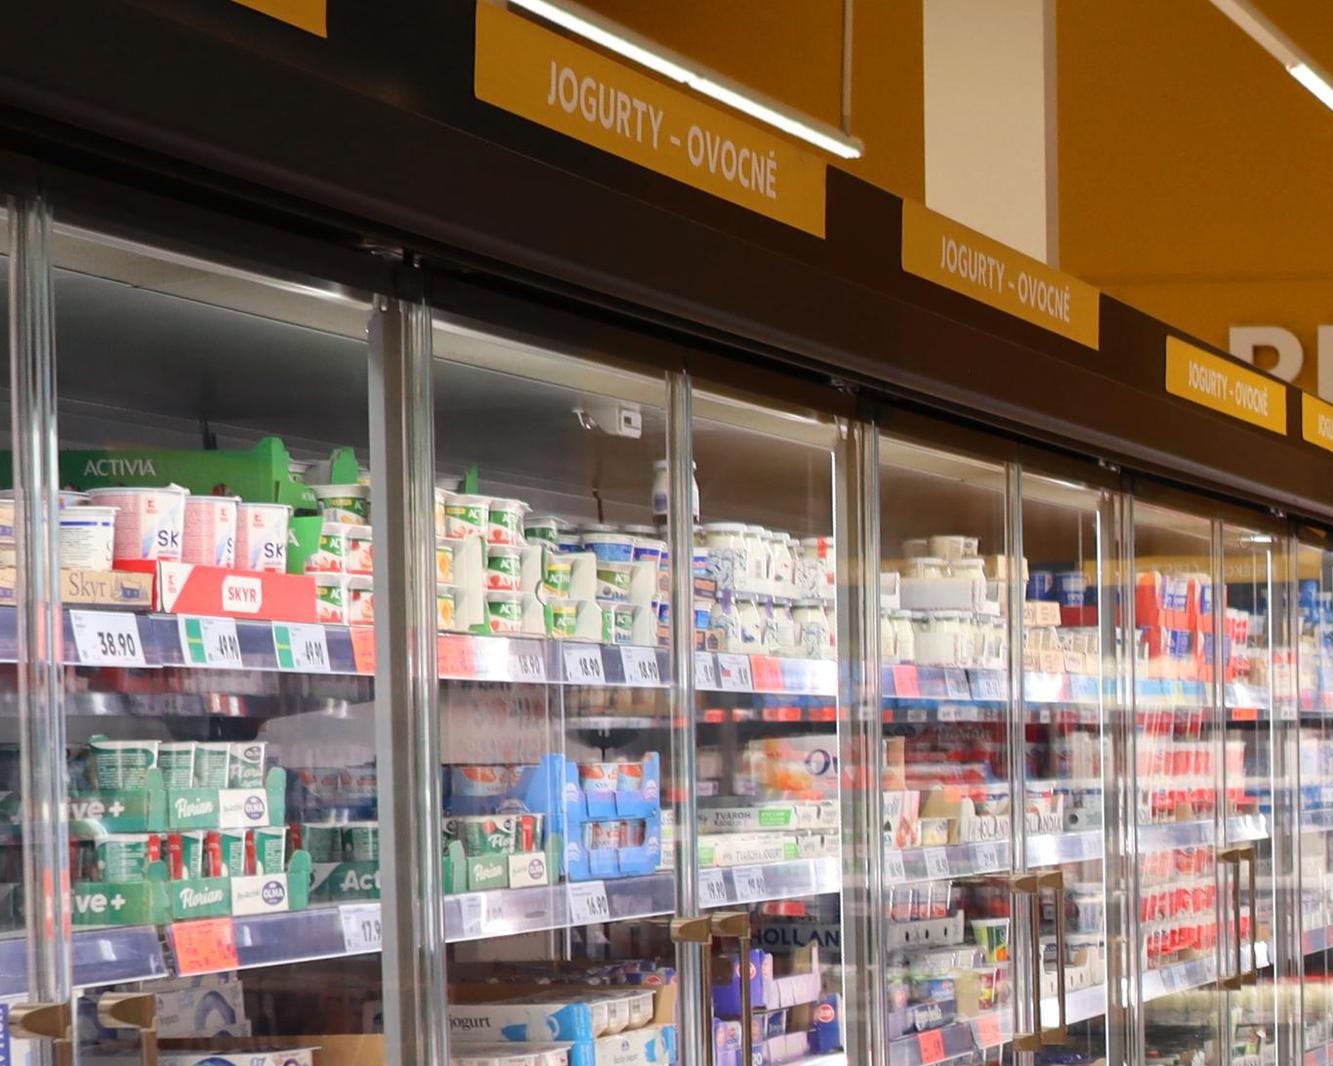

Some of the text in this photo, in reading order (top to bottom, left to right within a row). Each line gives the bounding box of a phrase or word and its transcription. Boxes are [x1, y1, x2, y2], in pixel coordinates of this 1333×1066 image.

[546, 60, 778, 200] JOGURTY OVOCNÉ
[939, 234, 1071, 324] JOGURTY OVOCNÉ
[1187, 360, 1270, 417] JOGURTY OVOCNÉ
[84, 457, 157, 478] ACTIVIA
[68, 571, 108, 600] Skyr
[227, 585, 258, 603] SKYR
[97, 631, 137, 658] 38.90
[174, 797, 215, 819] Florian
[179, 885, 224, 909] Florian
